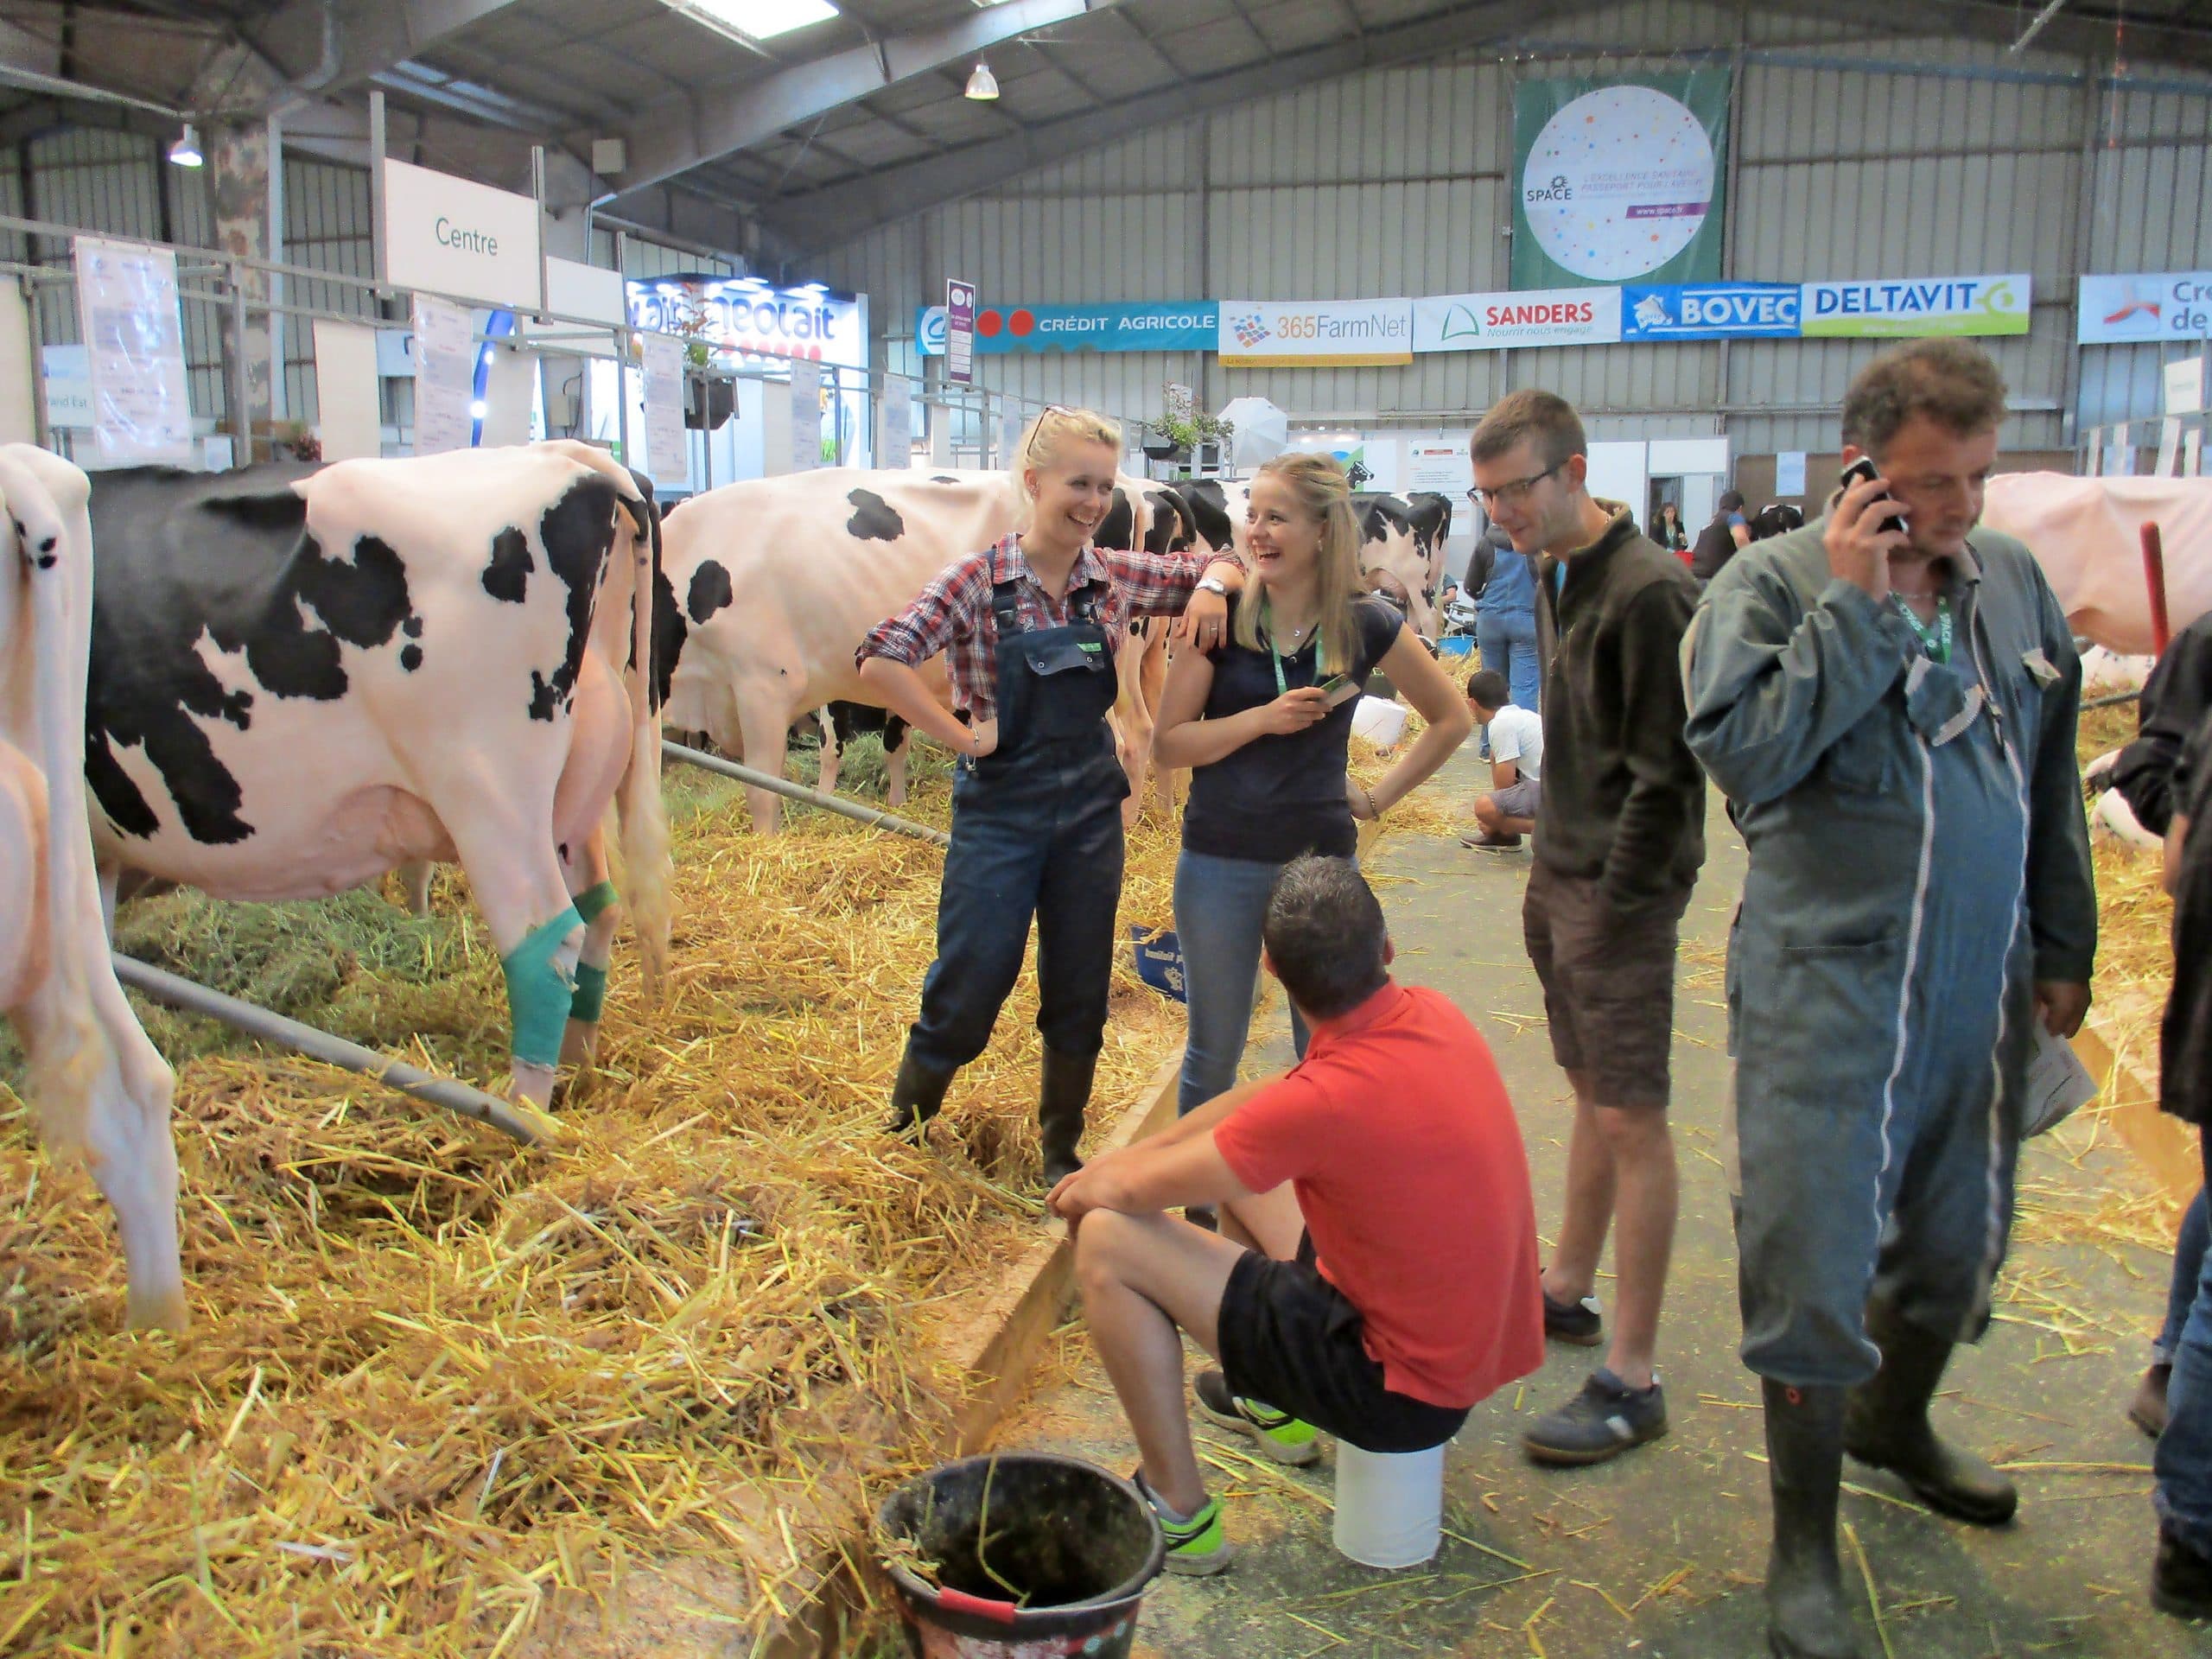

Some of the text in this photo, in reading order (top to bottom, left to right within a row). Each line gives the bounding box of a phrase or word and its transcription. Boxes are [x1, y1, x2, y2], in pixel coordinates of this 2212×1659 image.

[1527, 188, 1573, 201] SPACE
[435, 217, 499, 257] Centre
[1681, 296, 1796, 325] BOVEC
[1815, 283, 1978, 315] DELTAVIT
[1039, 315, 1216, 333] CRÉDIT AGRICOLE
[1276, 314, 1406, 340] 365FarmNet
[1485, 302, 1593, 327] SANDERS
[2171, 307, 2208, 330] de
